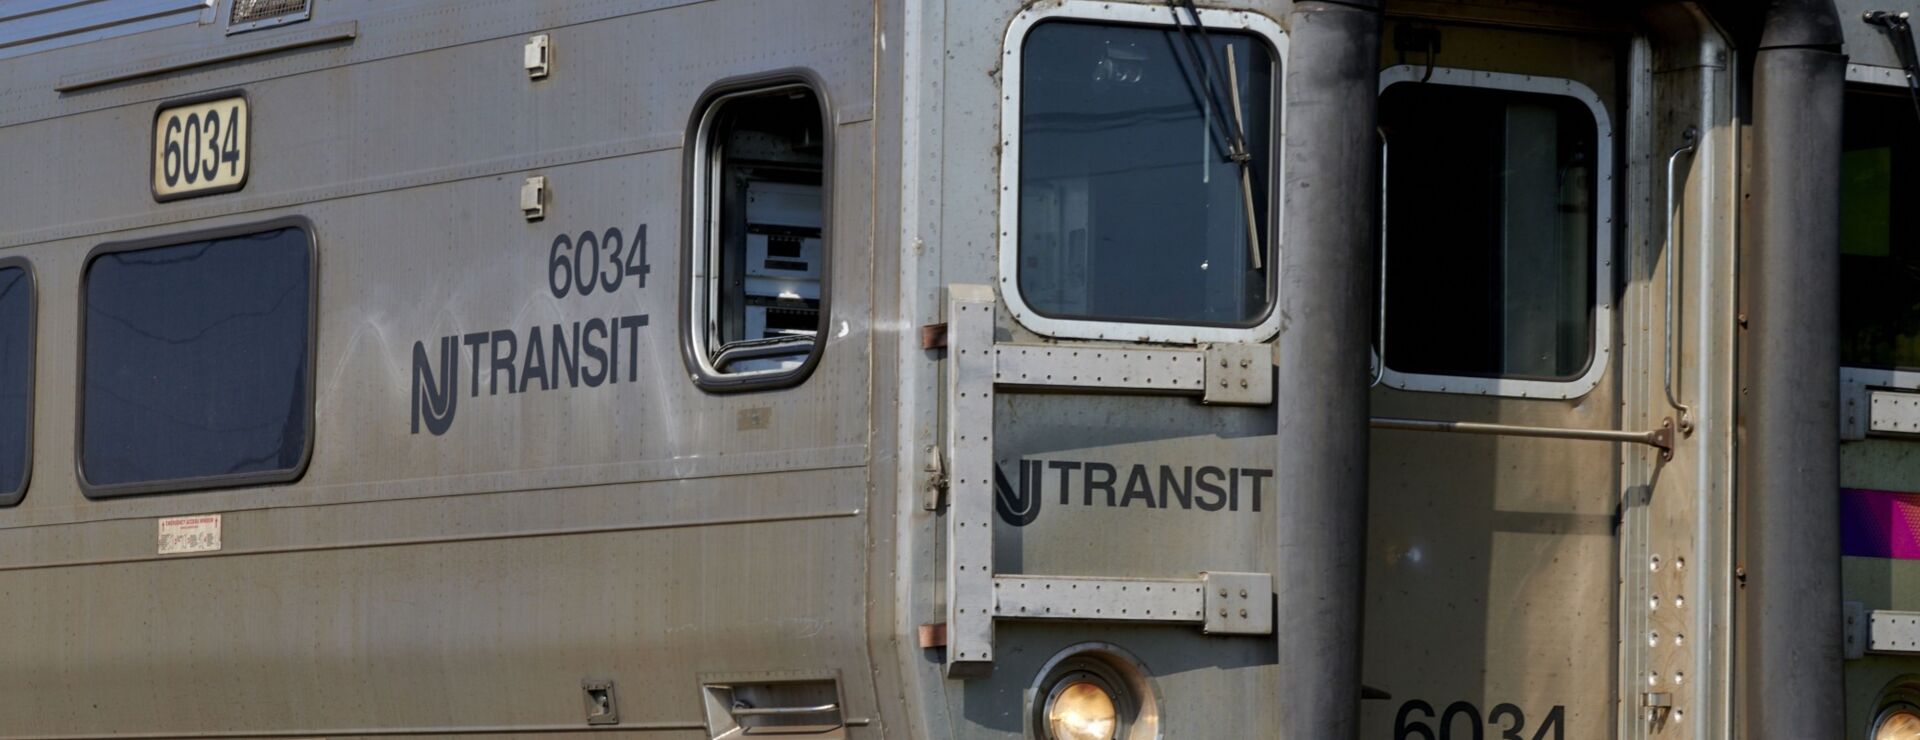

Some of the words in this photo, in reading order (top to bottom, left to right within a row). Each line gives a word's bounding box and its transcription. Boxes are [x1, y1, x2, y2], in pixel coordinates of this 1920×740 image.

[164, 106, 240, 187] 6034
[549, 224, 650, 299] 6034
[411, 335, 459, 436] NJ
[463, 314, 649, 397] TRANSIT
[1048, 460, 1274, 512] TRANSIT
